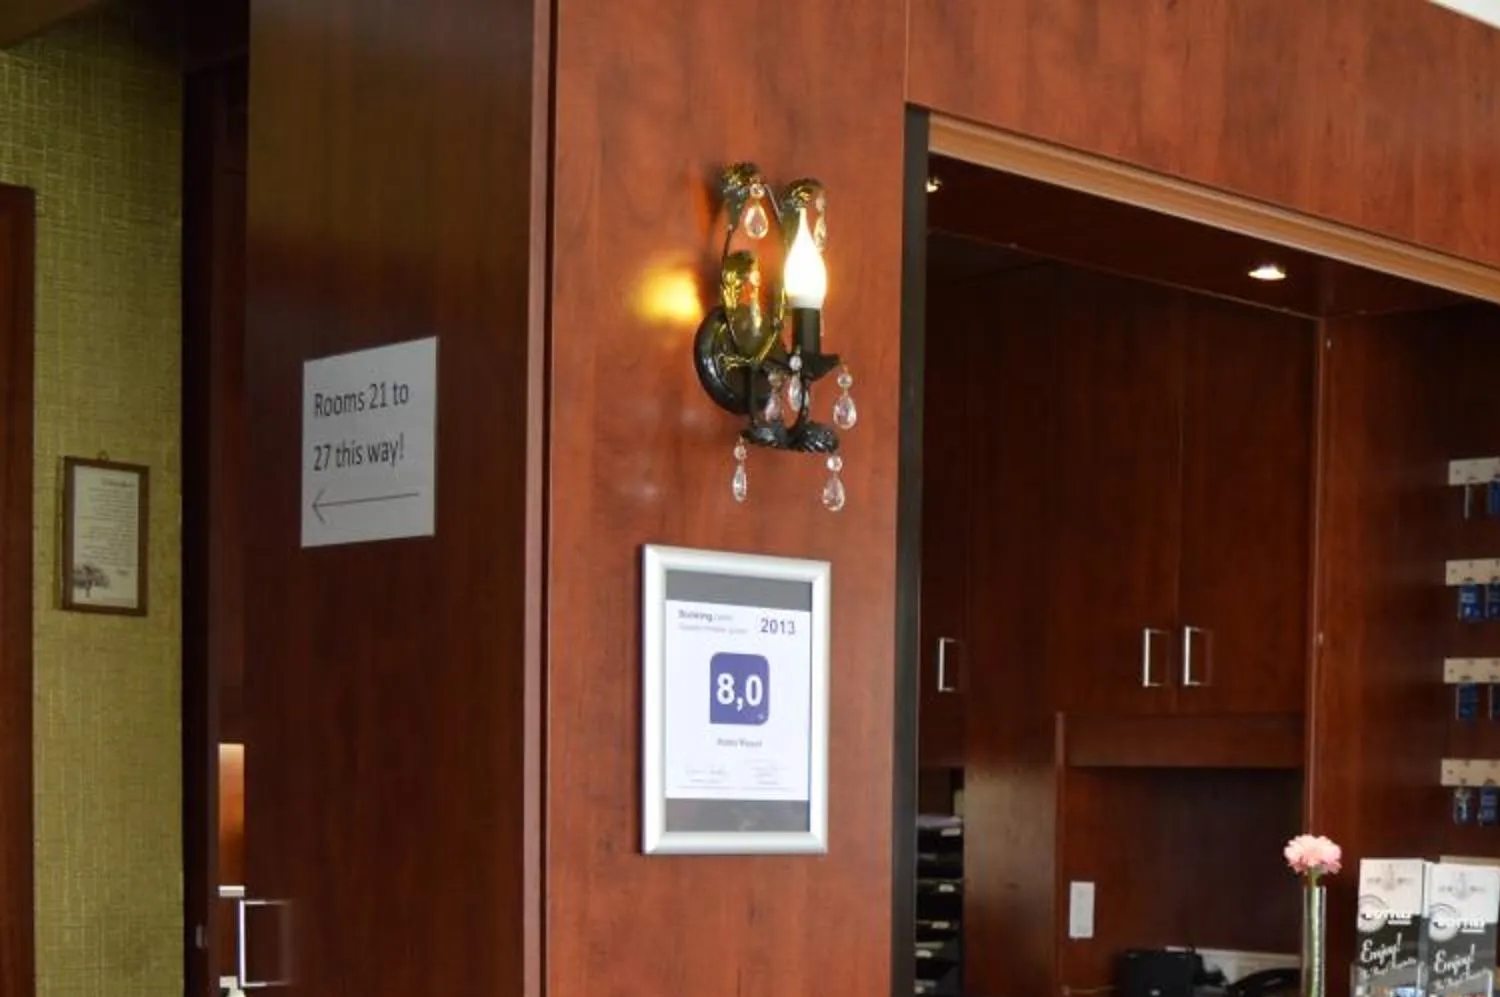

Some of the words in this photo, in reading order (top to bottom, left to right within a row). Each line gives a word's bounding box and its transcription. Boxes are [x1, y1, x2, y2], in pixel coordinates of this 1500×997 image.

[314, 391, 365, 418] Rooms
[368, 382, 387, 410] 21
[392, 381, 410, 406] to
[312, 444, 332, 471] 27
[335, 440, 363, 468] this
[367, 432, 405, 467] way!
[760, 616, 796, 636] 2013
[716, 672, 764, 711] 8,0
